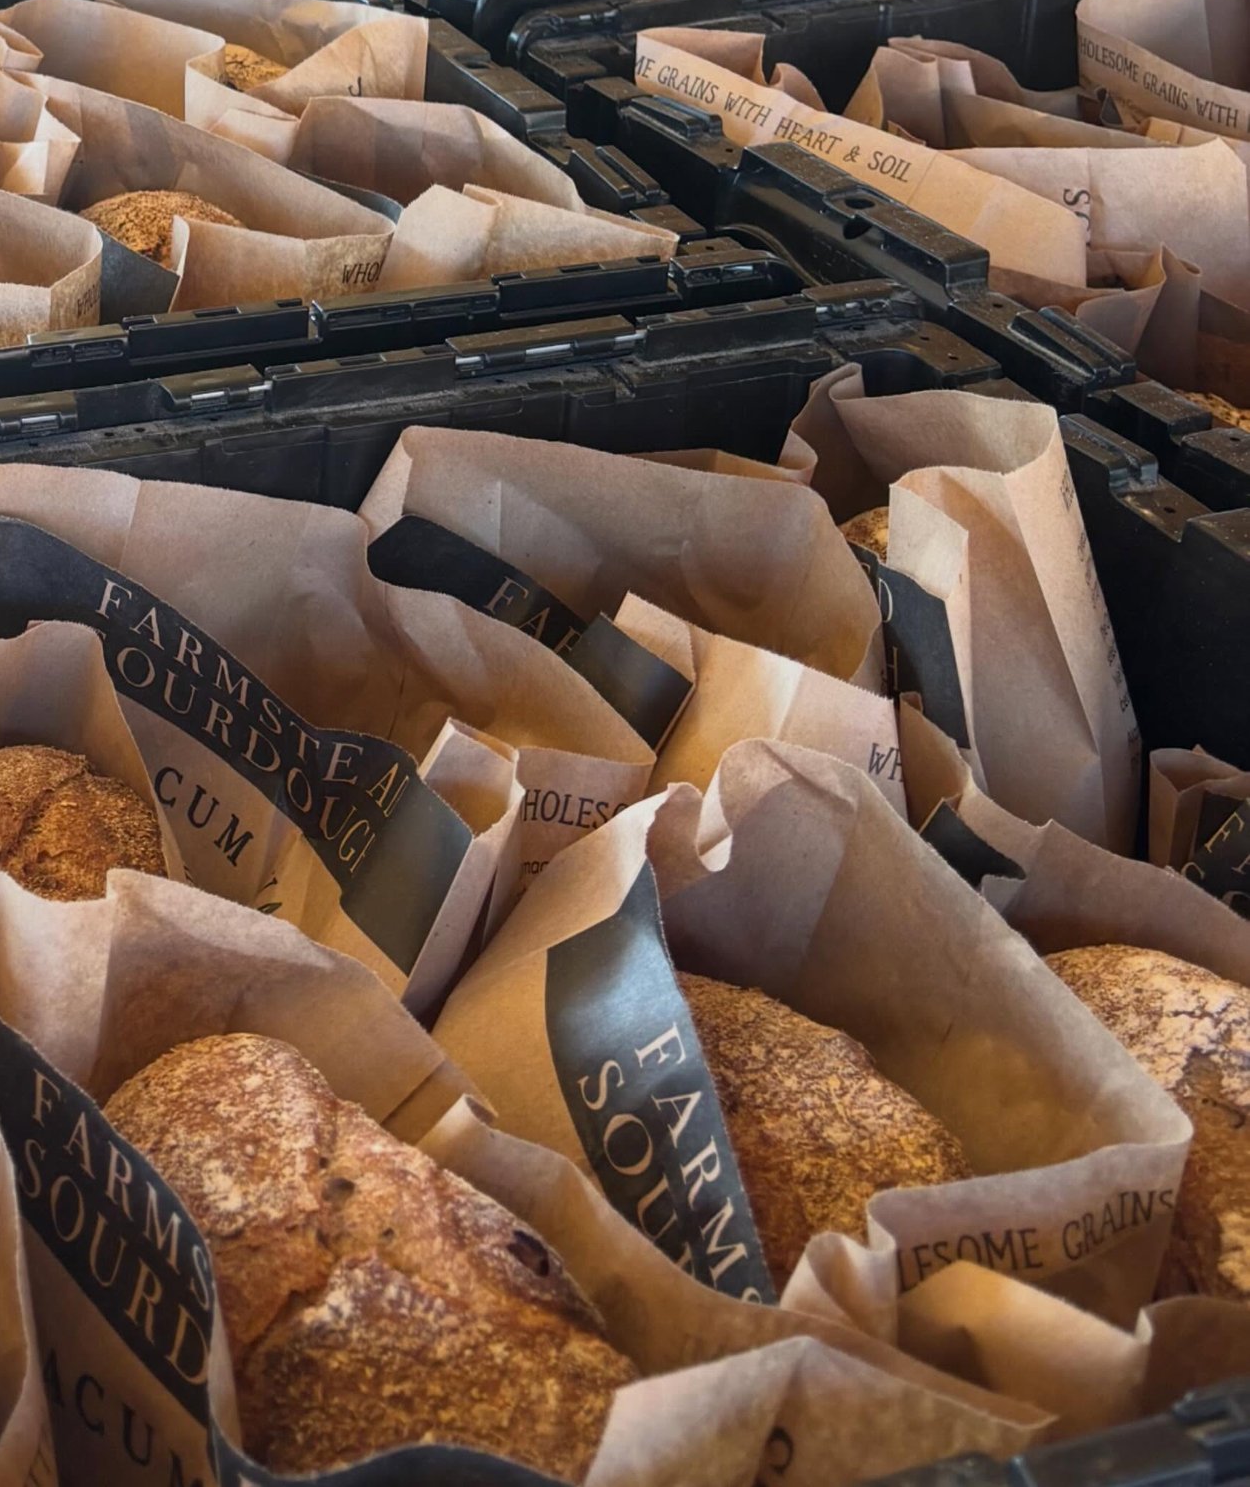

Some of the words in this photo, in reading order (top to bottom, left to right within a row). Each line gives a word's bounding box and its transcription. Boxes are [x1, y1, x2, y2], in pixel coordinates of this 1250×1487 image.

[657, 65, 719, 105] GRAINS
[724, 91, 772, 127] WITH
[774, 118, 842, 156] HEART
[842, 144, 861, 163] &
[867, 150, 912, 183] SOIL
[1143, 71, 1188, 111] GRAINS
[1196, 97, 1239, 129] WITH
[96, 631, 375, 873] OURDOUG
[19, 1139, 210, 1386] SOURD
[33, 1070, 213, 1312] FARMS
[1062, 1189, 1175, 1261] GRAINS
